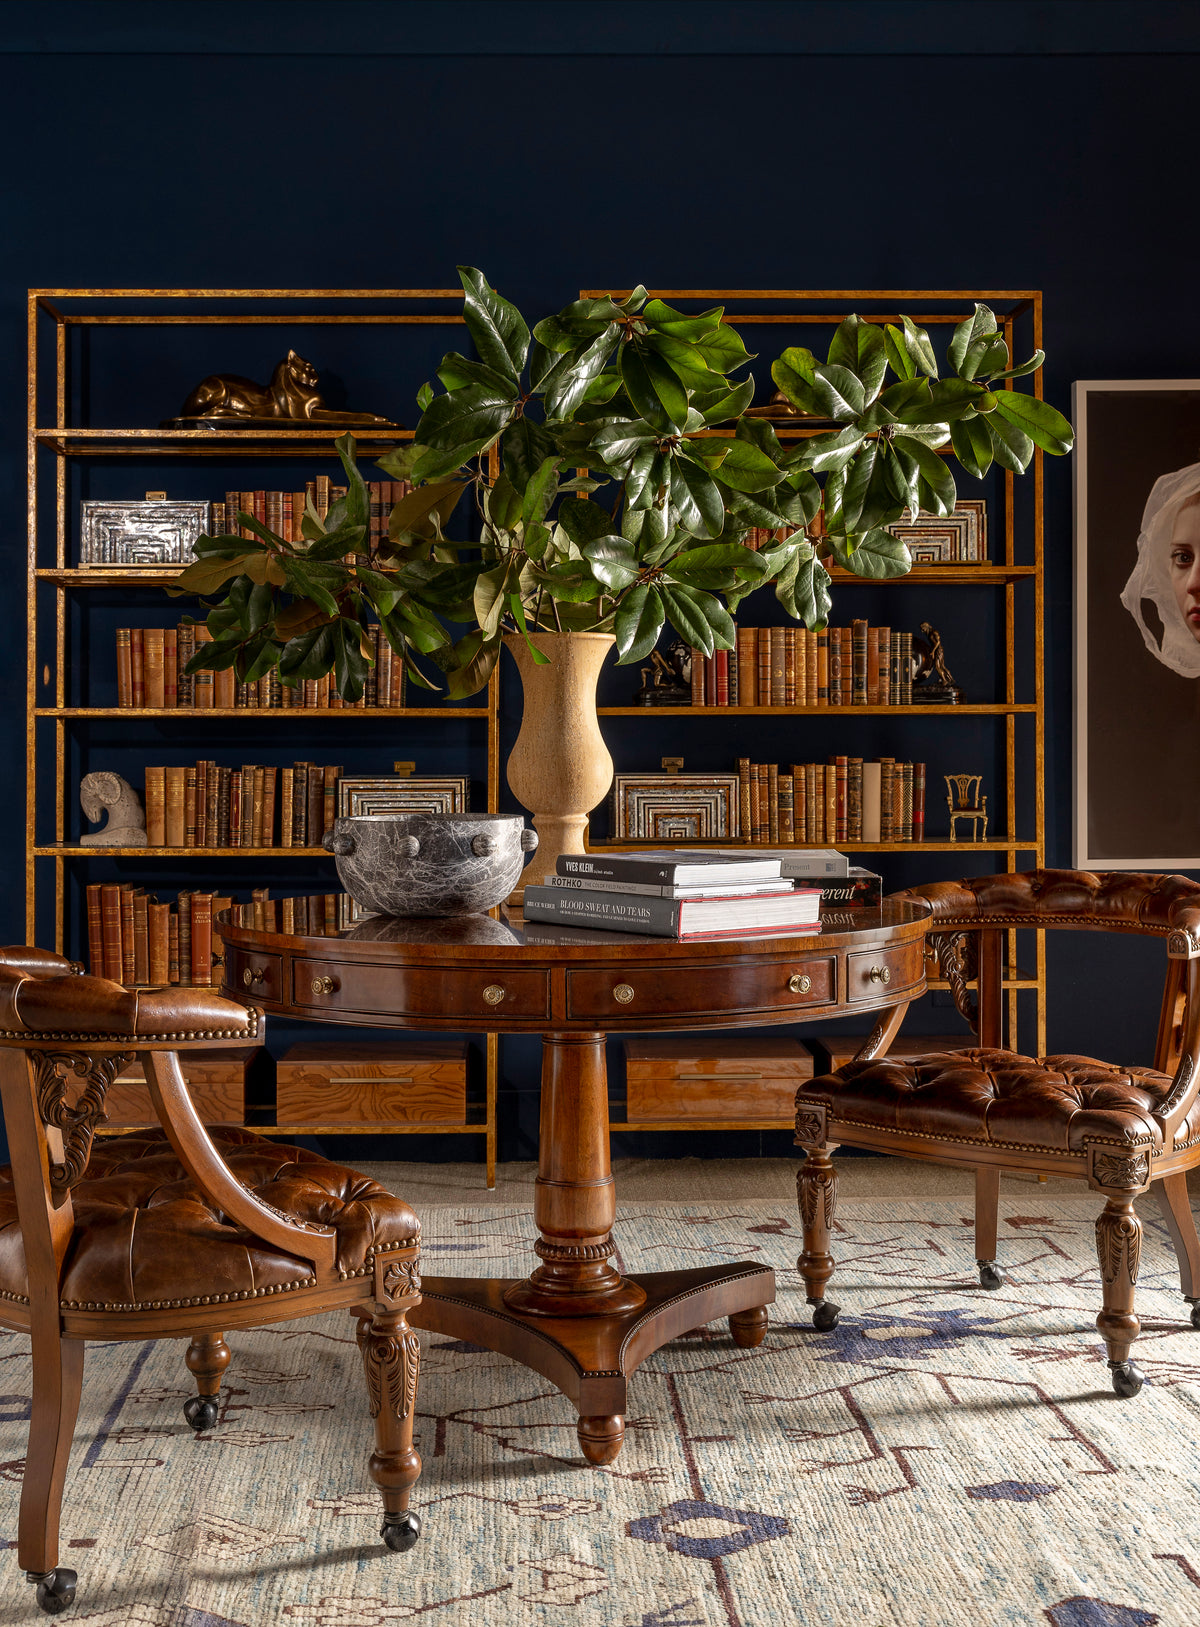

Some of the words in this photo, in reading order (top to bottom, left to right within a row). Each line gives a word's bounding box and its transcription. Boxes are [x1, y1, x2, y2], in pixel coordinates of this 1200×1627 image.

[566, 861, 579, 872] YVES
[579, 862, 594, 873] KLEIN
[784, 863, 810, 871] Present
[551, 877, 582, 888] ROTHKO
[560, 899, 584, 911] BLOOD
[585, 902, 609, 914] SWEAT
[611, 905, 626, 916] AND
[627, 907, 651, 918] TEARS
